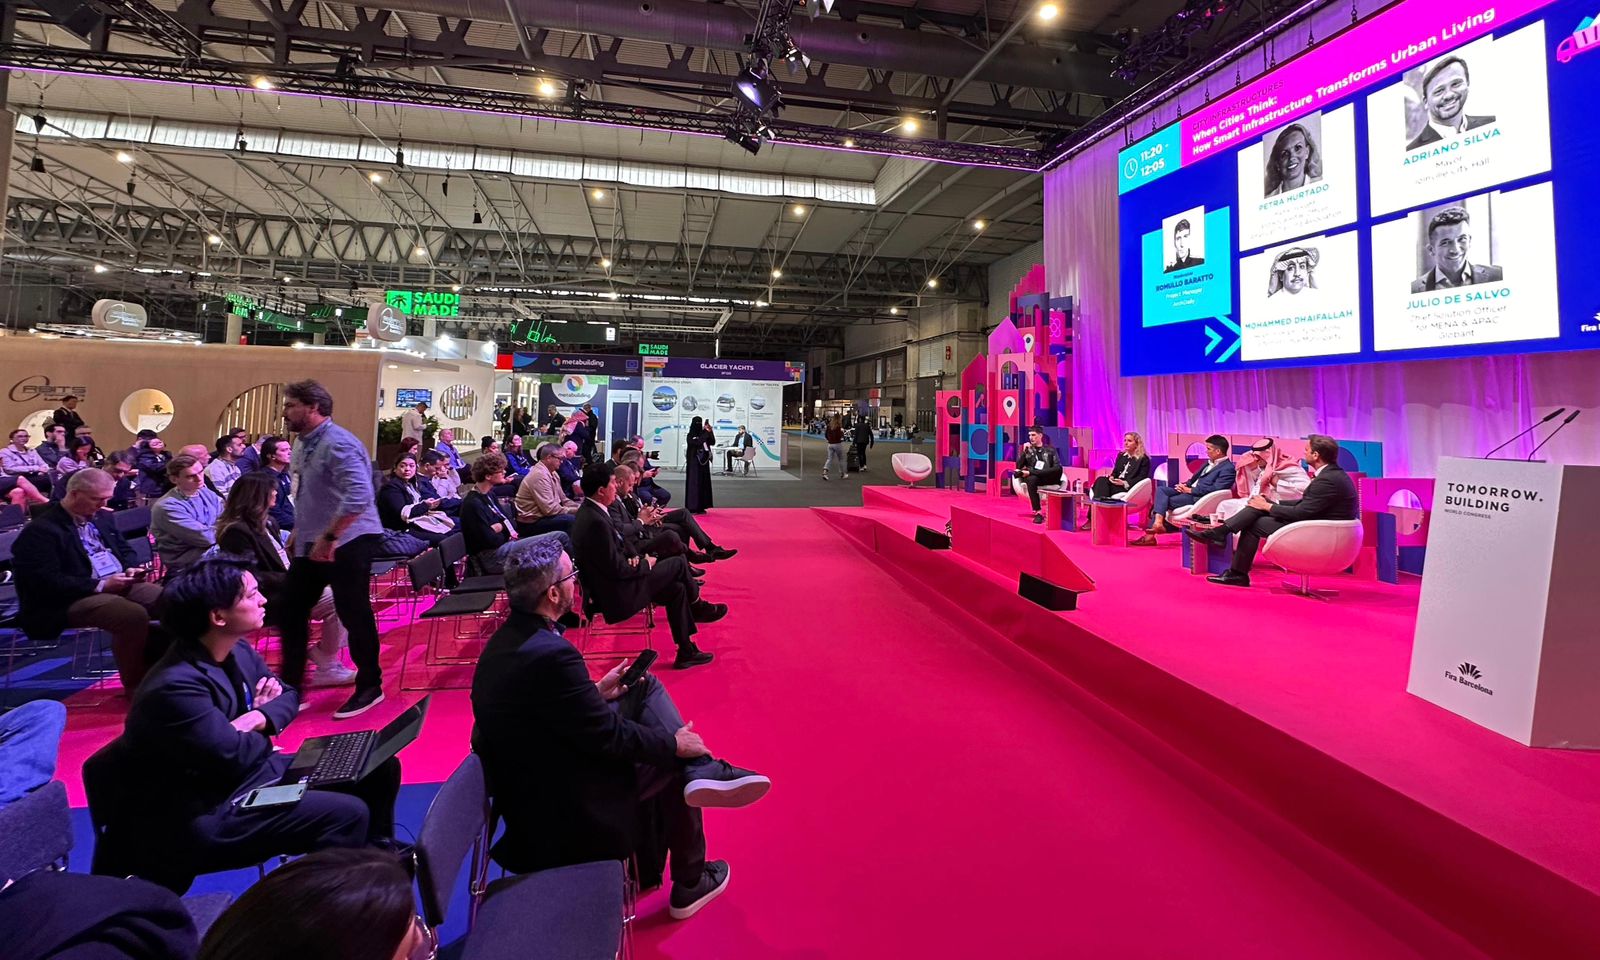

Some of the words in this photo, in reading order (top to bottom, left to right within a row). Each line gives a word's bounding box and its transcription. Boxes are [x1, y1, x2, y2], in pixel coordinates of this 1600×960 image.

[1192, 142, 1211, 156] How
[1213, 129, 1240, 146] Smart
[1242, 94, 1312, 132] Infrastructure
[1316, 58, 1387, 98] Transforms
[1391, 36, 1437, 64] Urban
[1441, 7, 1496, 40] Living
[1208, 79, 1284, 124] INFRASTRUCTURES
[1192, 126, 1217, 143] When
[1219, 113, 1245, 130] Cities
[1248, 95, 1278, 115] Think:
[1140, 143, 1163, 162] 11:20
[1403, 141, 1460, 165] ADRIANO
[1463, 127, 1501, 146] SILVA
[1140, 158, 1165, 177] 12:05
[1258, 198, 1285, 211] PETRA
[1286, 183, 1330, 203] HURTADO
[1155, 280, 1183, 292] ROMULLO
[1184, 273, 1214, 286] BARATTO
[414, 292, 460, 305] SAUDI
[1406, 297, 1441, 310] JULIO
[1444, 294, 1461, 305] DE
[1465, 287, 1511, 302] SALVO
[414, 304, 459, 317] MADE
[1245, 316, 1292, 330] MOHAMMED
[1294, 309, 1353, 325] DHAIFALLAH
[1581, 324, 1597, 333] Fira
[561, 358, 605, 368] metabuilding
[1447, 482, 1544, 502] TOMORROW.
[1445, 495, 1510, 512] BUILDING
[1444, 508, 1463, 516] WORLD
[1463, 510, 1492, 519] CONGRESS
[1444, 670, 1458, 682] Fira
[1458, 676, 1494, 696] Barcelona
